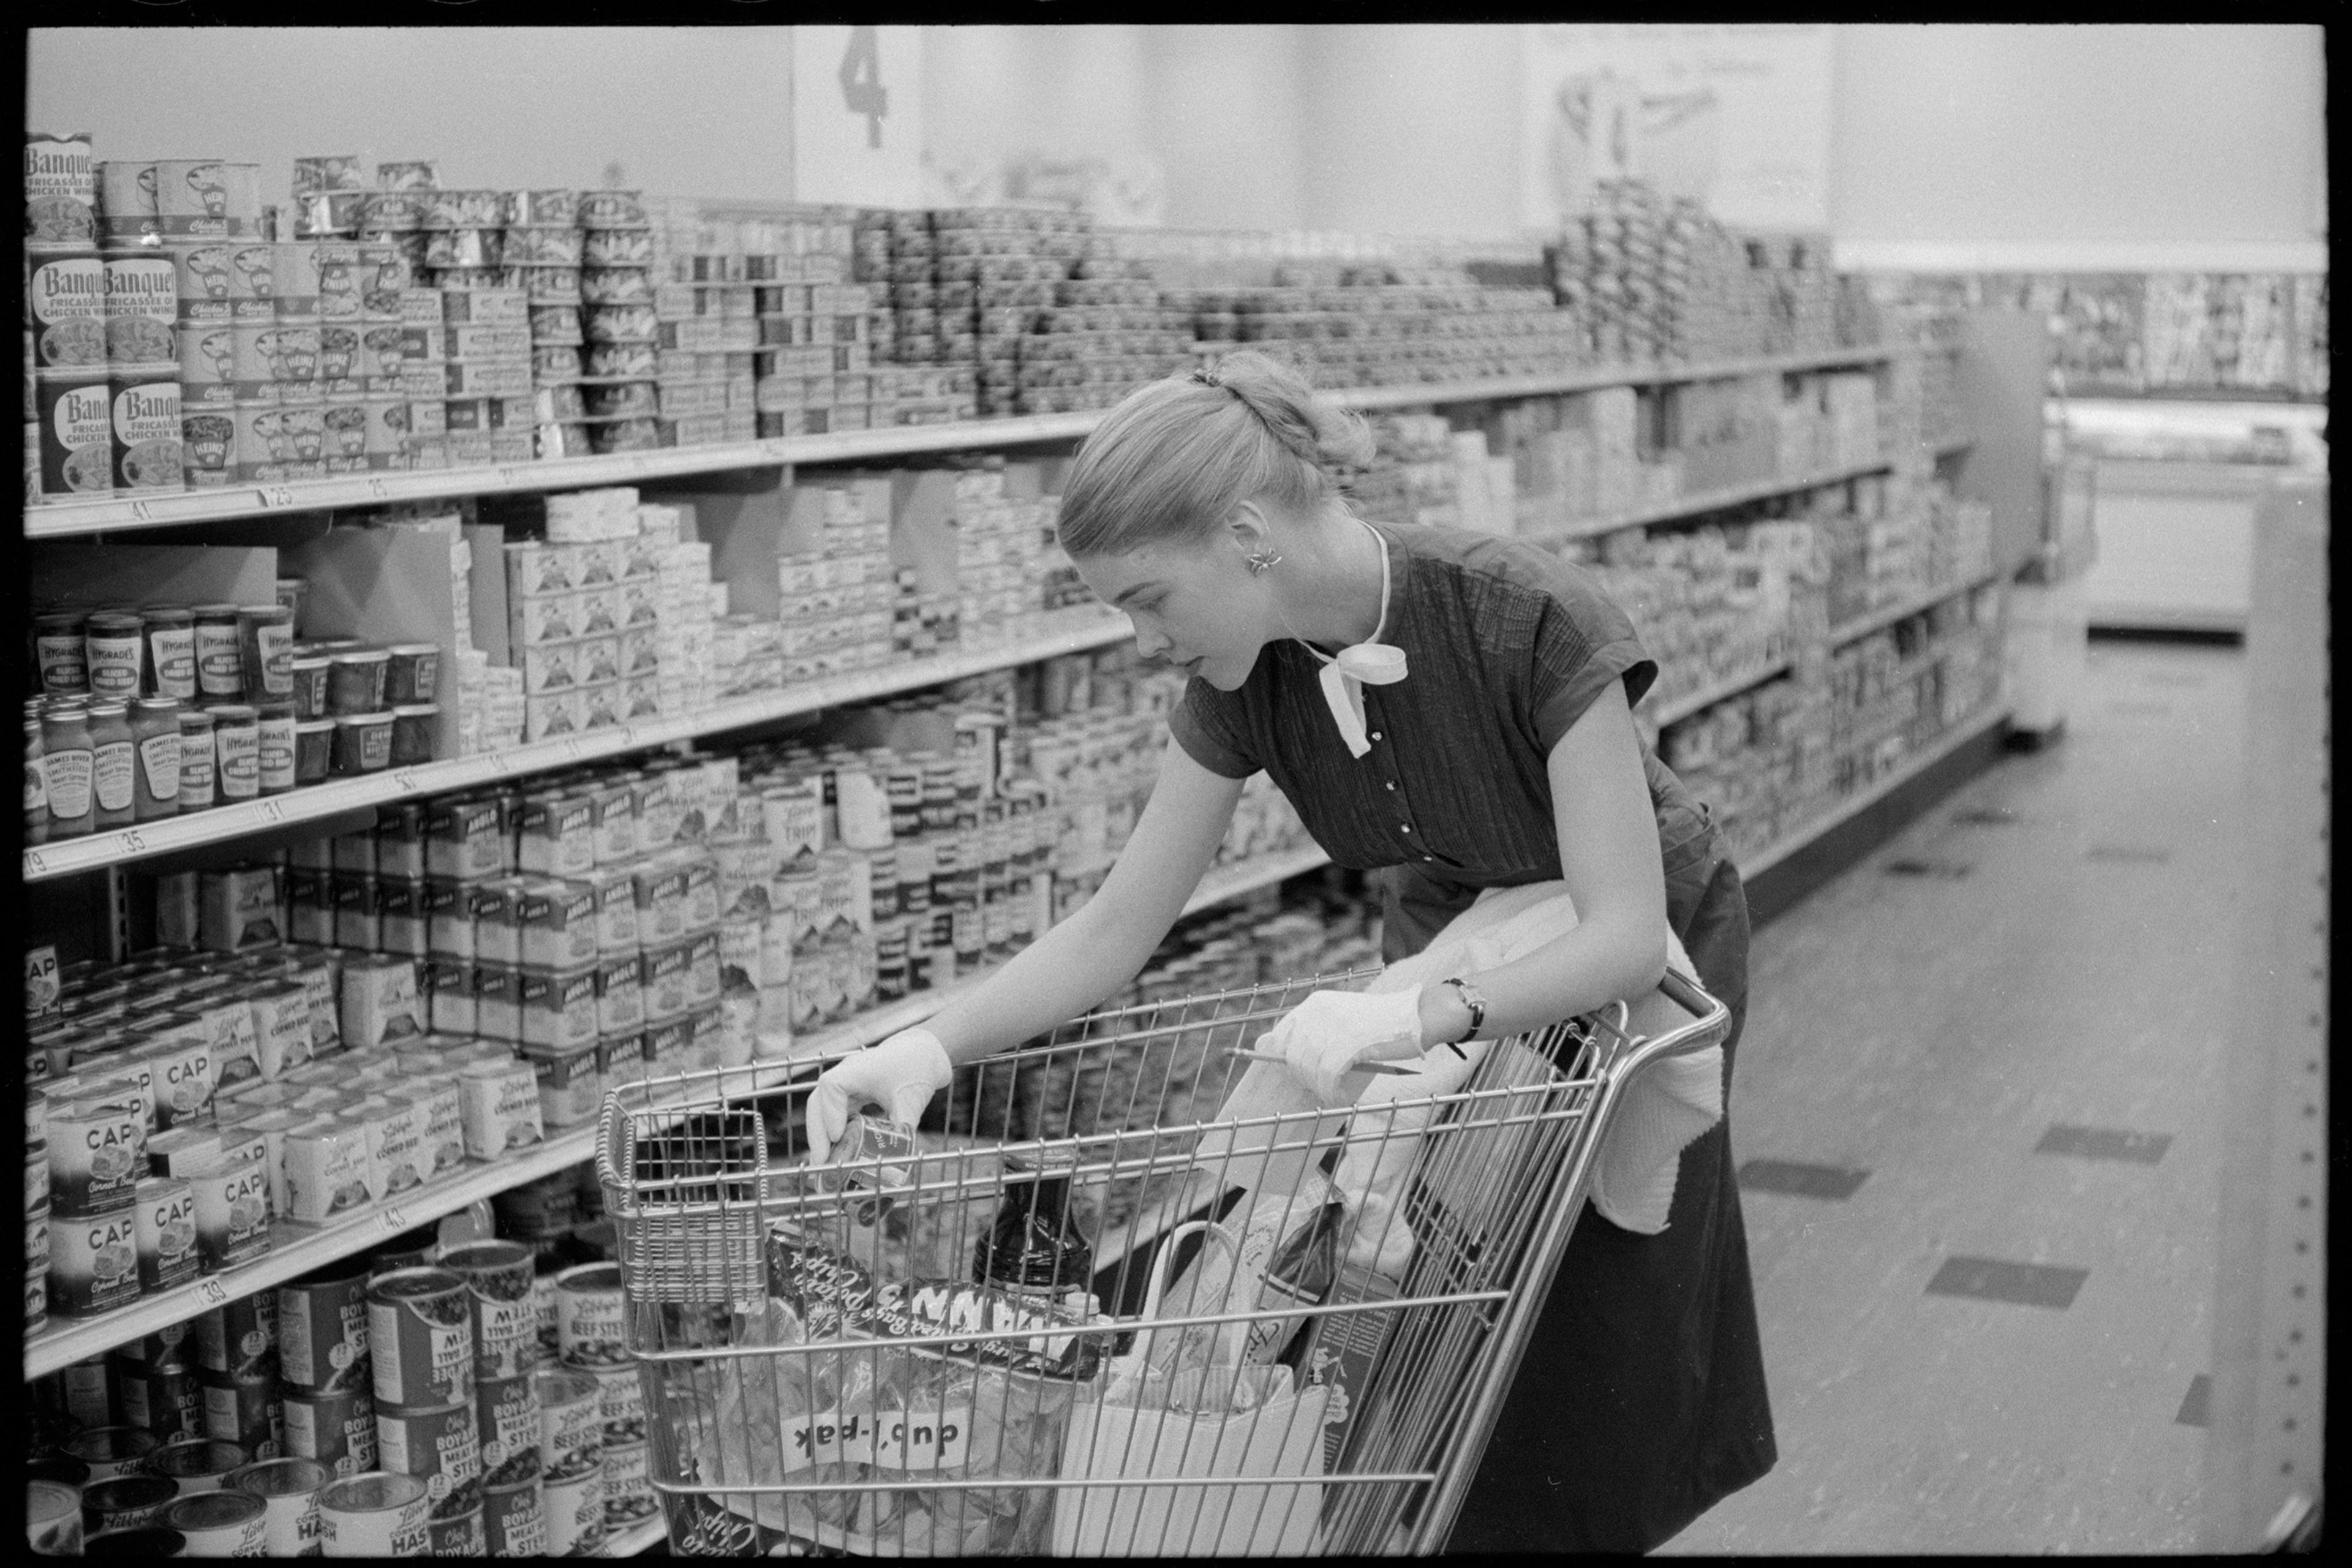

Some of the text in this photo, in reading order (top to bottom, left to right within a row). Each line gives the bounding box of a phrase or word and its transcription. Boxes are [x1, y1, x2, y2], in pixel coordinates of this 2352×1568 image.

[838, 23, 888, 149] 4
[26, 148, 91, 179] Banque
[195, 442, 225, 456] HEINZ
[47, 755, 70, 766] JAMES
[167, 1057, 208, 1084] CAP
[86, 1124, 131, 1150] CAP
[225, 1173, 261, 1202] CAP
[154, 1198, 193, 1227] CAP
[89, 1220, 132, 1250] CAP
[391, 1527, 426, 1556] HAS
